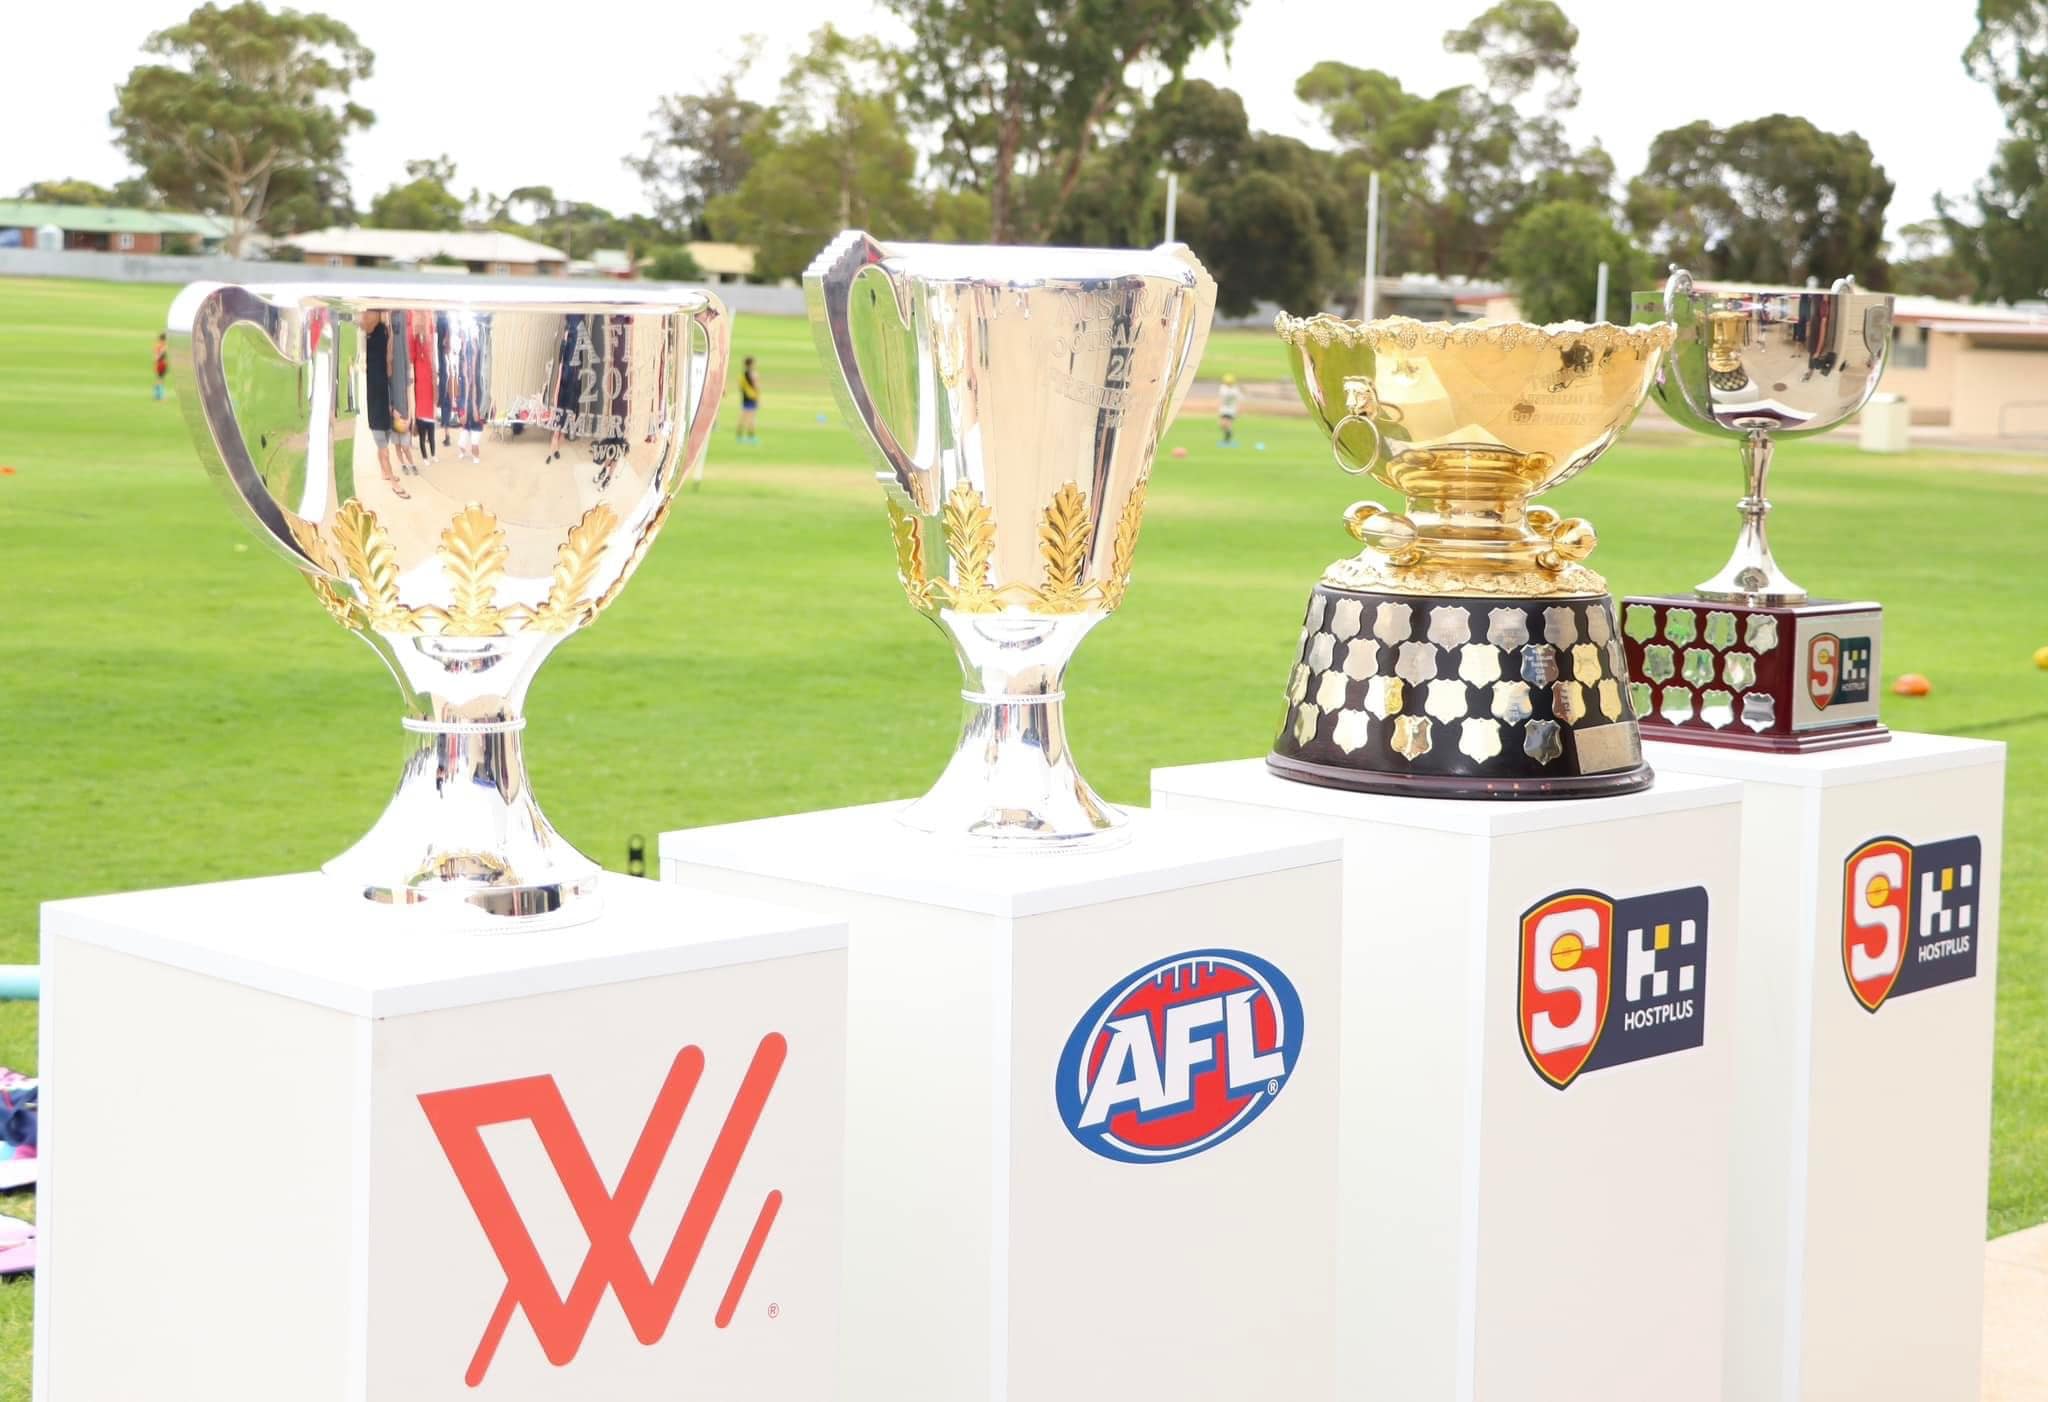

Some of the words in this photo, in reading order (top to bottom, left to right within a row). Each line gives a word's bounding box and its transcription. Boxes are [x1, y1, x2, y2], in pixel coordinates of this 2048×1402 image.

[592, 443, 628, 461] WON
[1811, 640, 1835, 697] S
[1850, 852, 1903, 983] S
[1918, 935, 1970, 963] HOSTPLUS
[1531, 908, 1601, 1056] S
[1624, 1000, 1694, 1031] HOSTPLUS
[1077, 987, 1286, 1129] AFL
